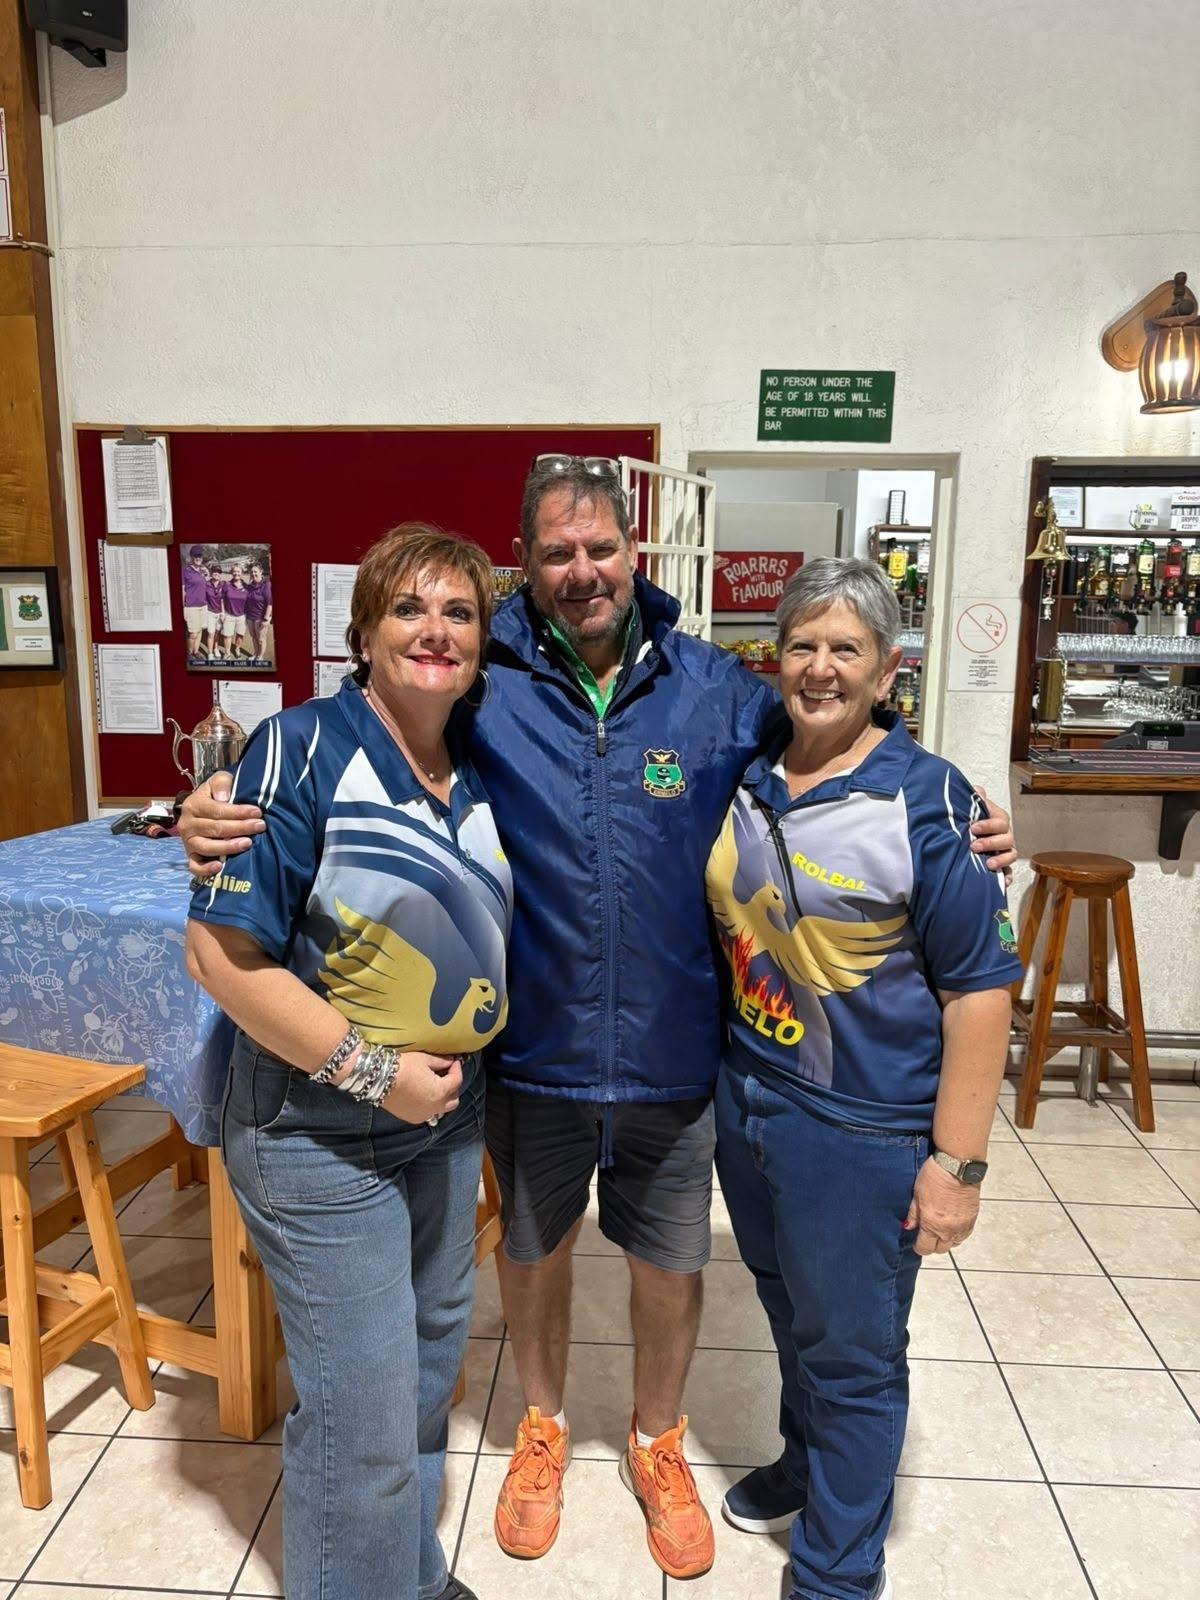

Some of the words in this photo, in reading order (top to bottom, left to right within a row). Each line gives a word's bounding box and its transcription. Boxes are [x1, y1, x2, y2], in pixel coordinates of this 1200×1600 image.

[766, 376, 778, 386] NO
[783, 376, 817, 387] PERSON
[822, 377, 851, 387] UNDER
[857, 377, 873, 388] THE
[765, 391, 783, 401] AGE
[787, 391, 799, 401] OF
[804, 392, 813, 402] 18
[818, 392, 846, 402] YEARS
[851, 392, 871, 403] WILL
[765, 407, 777, 417] BE
[781, 407, 829, 418] PERMITTED
[834, 407, 863, 418] WITHIN
[867, 407, 887, 418] THIS
[764, 421, 782, 431] BAR
[722, 556, 789, 585] ROARRRS
[749, 573, 766, 583] WITH
[731, 579, 784, 604] FLAVOUR
[791, 851, 867, 893] ROLBAL
